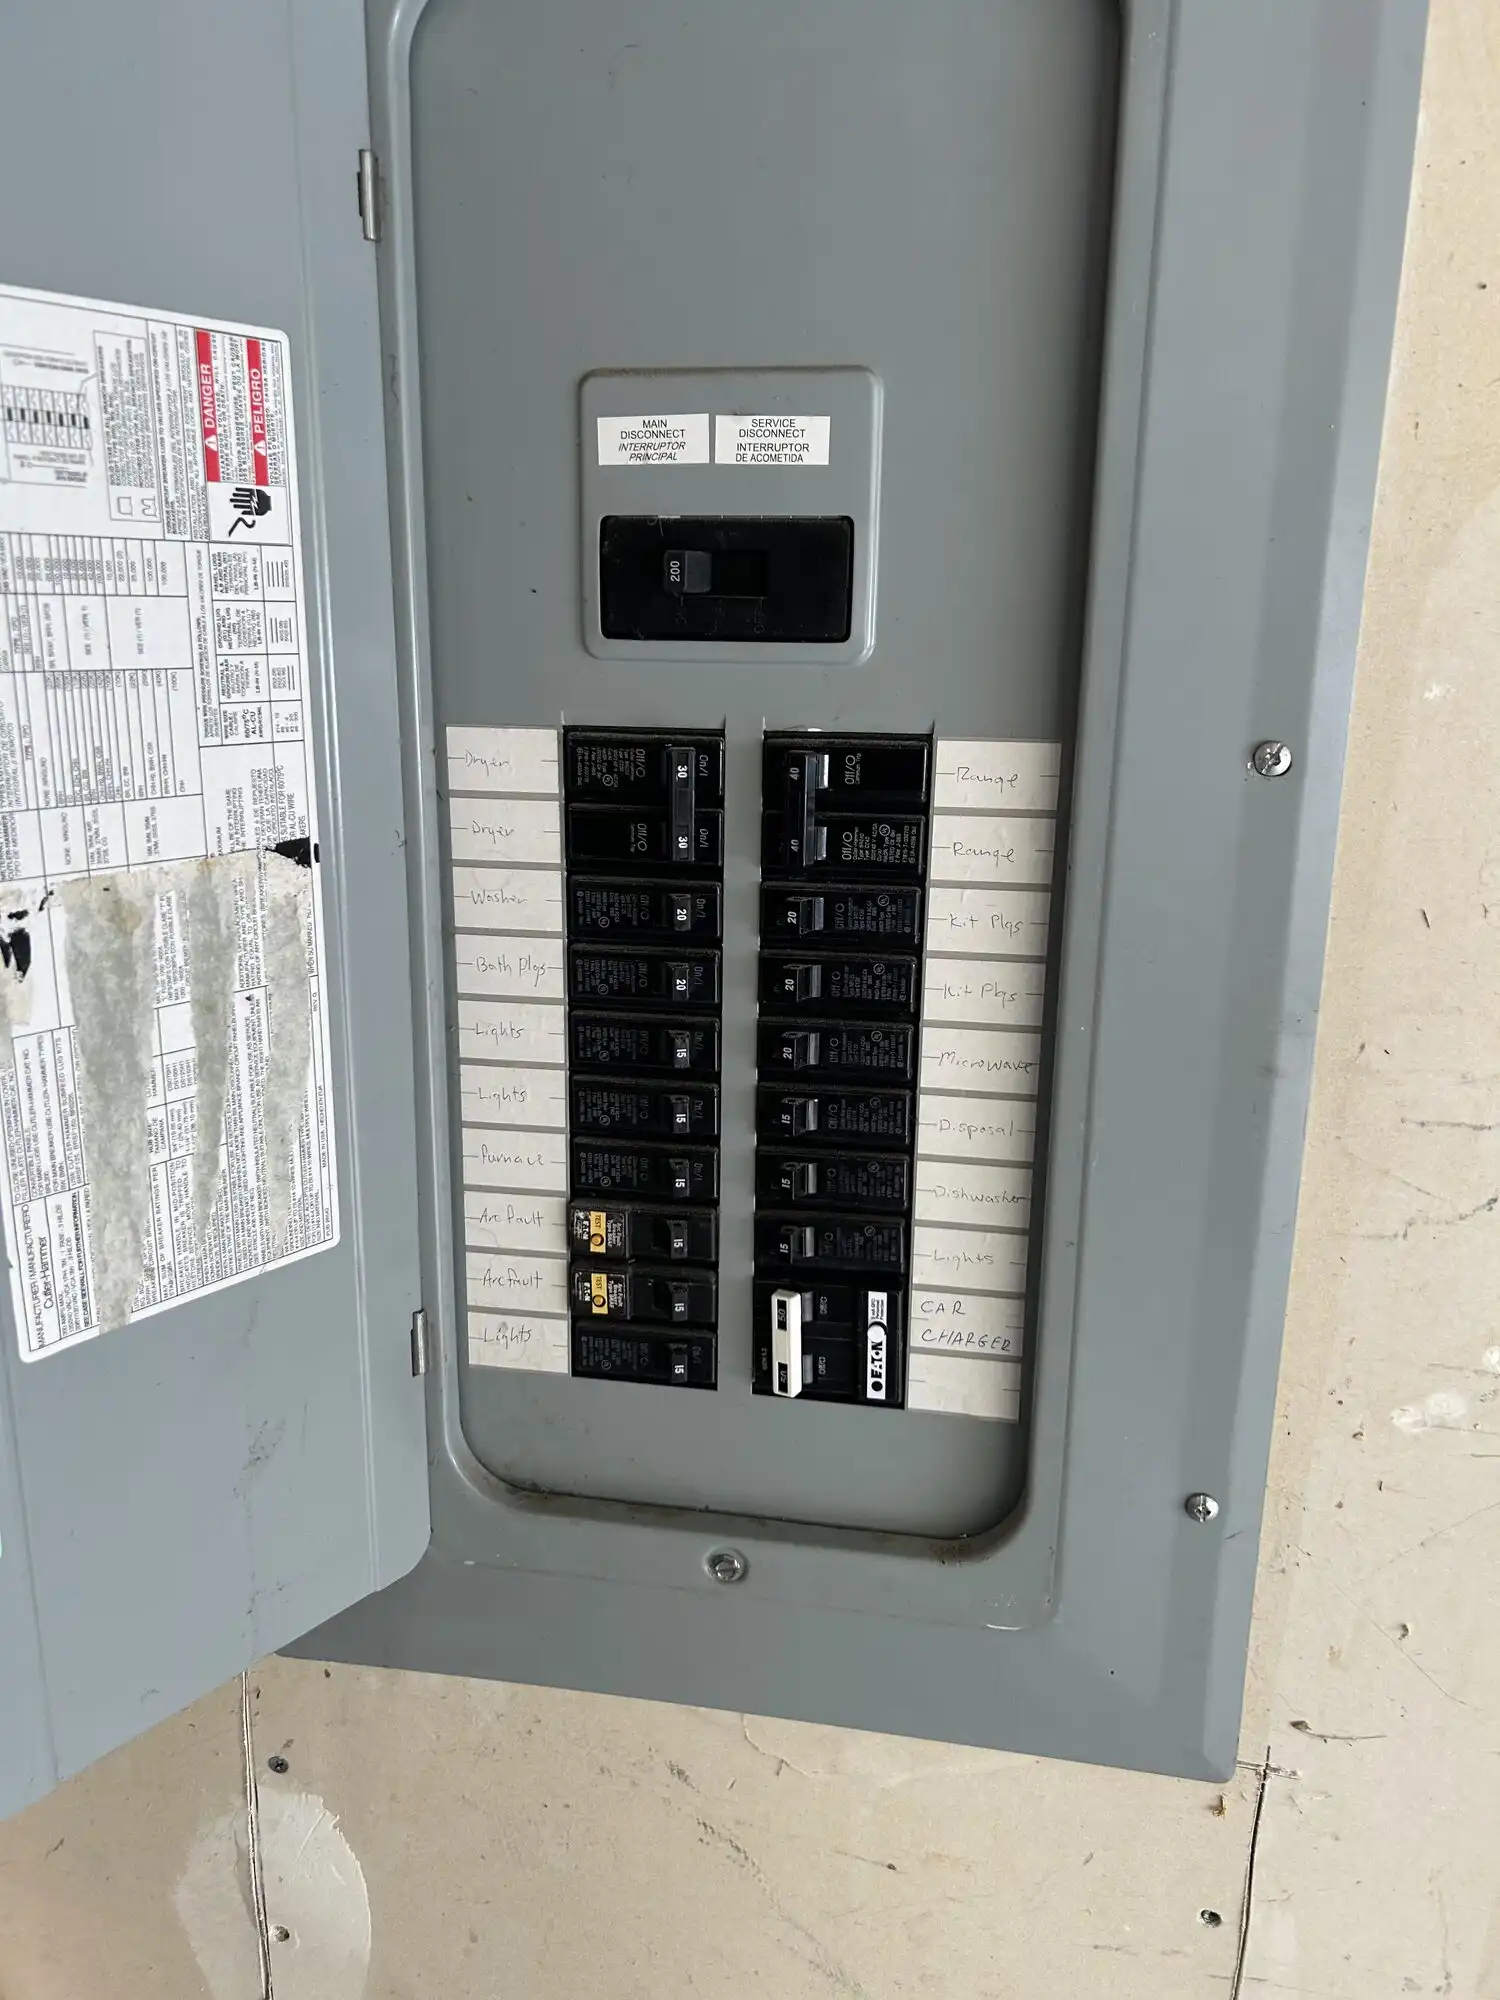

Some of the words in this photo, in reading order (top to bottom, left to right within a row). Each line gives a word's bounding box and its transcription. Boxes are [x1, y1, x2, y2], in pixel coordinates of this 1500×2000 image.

[200, 362, 215, 429] DANGER
[250, 367, 264, 434] PELIGRO
[642, 419, 668, 428] MAIN
[751, 418, 796, 428] SERVICE
[620, 429, 686, 440] DISCONNECT
[738, 428, 806, 439] DISCONNECT
[618, 441, 686, 452] INTERRUPTOR
[736, 442, 810, 453] INTERRUPTOR
[628, 451, 678, 462] PRINCIPAL
[735, 453, 748, 463] DE
[750, 453, 804, 463] ACOMETIDA
[670, 560, 681, 582] 200
[678, 766, 687, 778] 30
[790, 767, 799, 780] 40
[957, 766, 1019, 793] Range
[472, 821, 514, 844] Dryer
[678, 836, 688, 848] 30
[791, 840, 799, 852] 40
[953, 842, 1015, 867] Range
[677, 908, 686, 920] 20
[788, 911, 797, 924] 20
[676, 978, 686, 990] 20
[785, 979, 794, 991] 20
[476, 1022, 524, 1045] Lights
[677, 1048, 686, 1058] 15
[783, 1047, 792, 1059] 20
[479, 1086, 527, 1109] Lights
[676, 1113, 686, 1123] 15
[782, 1114, 790, 1124] 15
[675, 1178, 685, 1188] 15
[782, 1178, 790, 1188] 15
[673, 1239, 683, 1247] 15
[780, 1243, 788, 1253] 15
[934, 1249, 994, 1270] Lights
[35, 1234, 54, 1310] Cutler-Hammer
[674, 1303, 684, 1312] 15
[920, 1300, 966, 1315] CAR
[778, 1309, 786, 1321] 50
[484, 1324, 532, 1349] Lights
[921, 1328, 1012, 1352] CHARGER
[674, 1365, 684, 1373] 15
